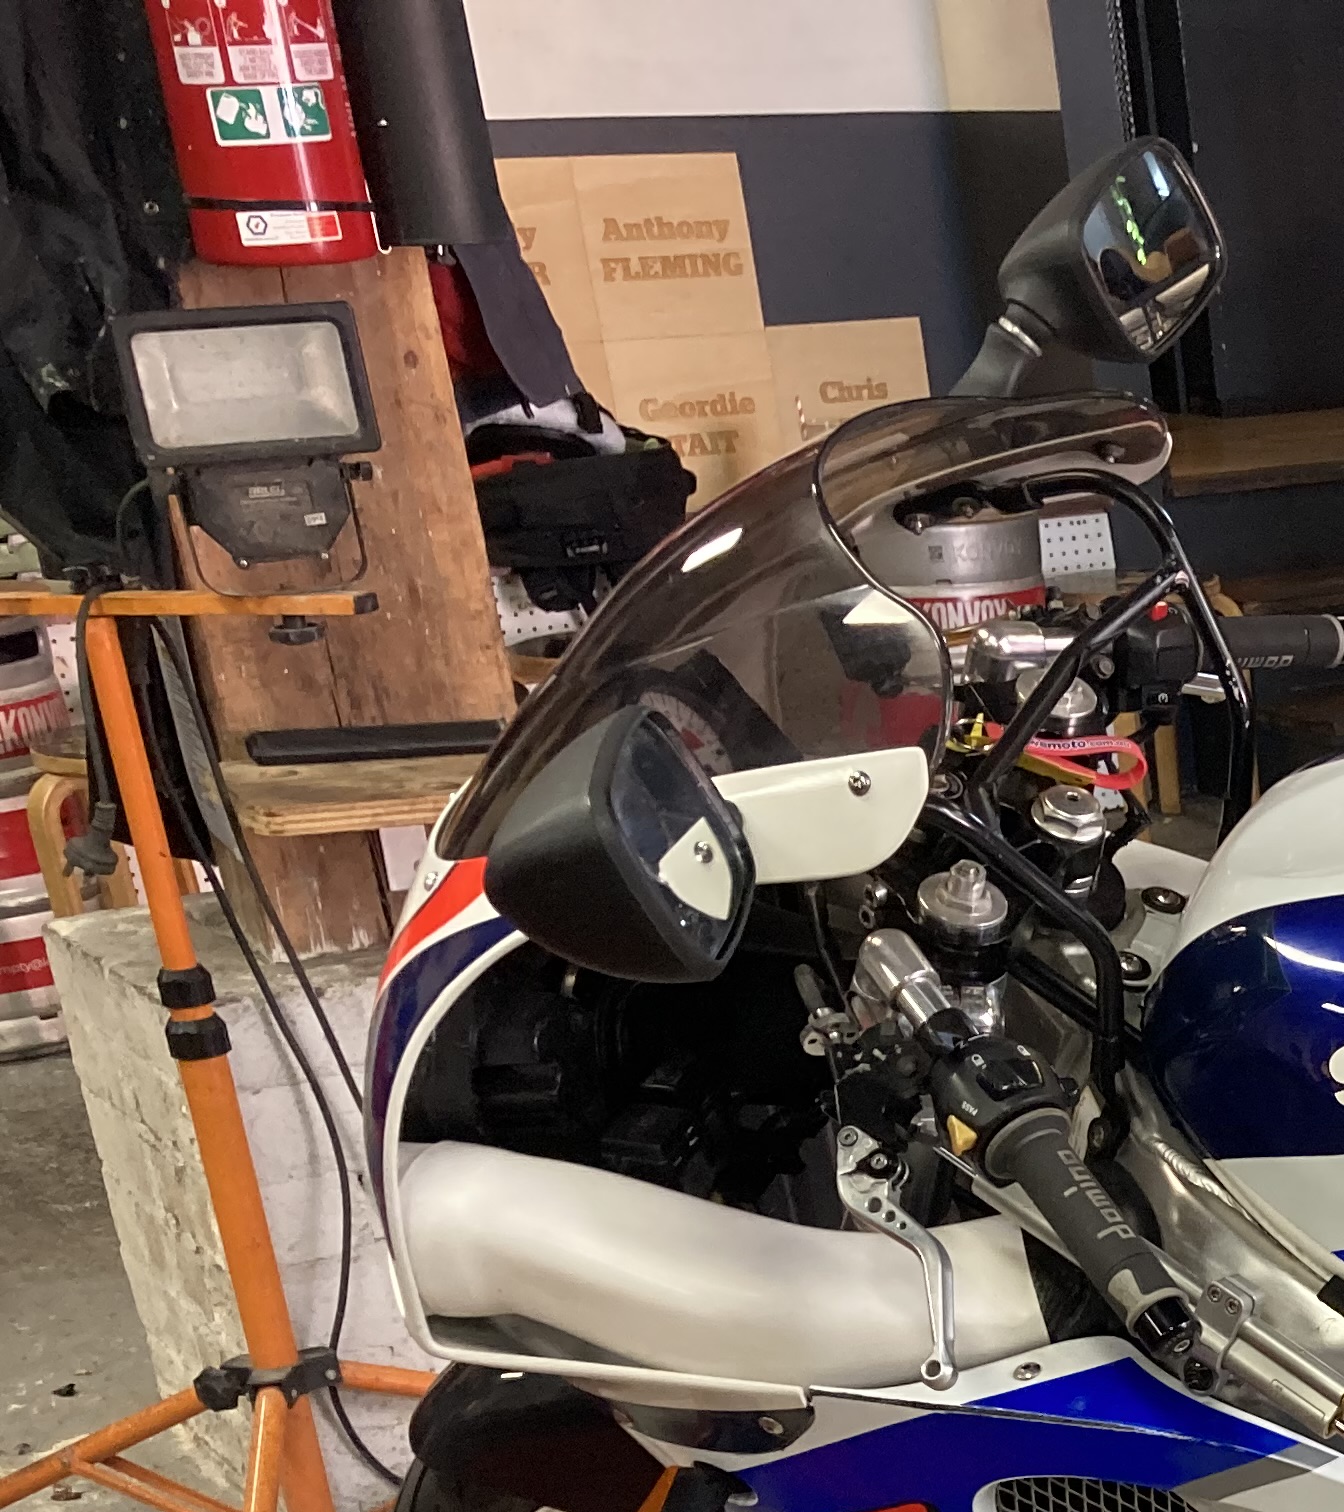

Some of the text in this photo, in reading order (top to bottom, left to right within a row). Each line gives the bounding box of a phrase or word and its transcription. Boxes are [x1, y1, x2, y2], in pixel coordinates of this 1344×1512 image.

[602, 216, 730, 243] Anthony
[601, 252, 744, 283] FLEMING
[819, 377, 888, 404] Chris
[639, 391, 756, 422] Geordie
